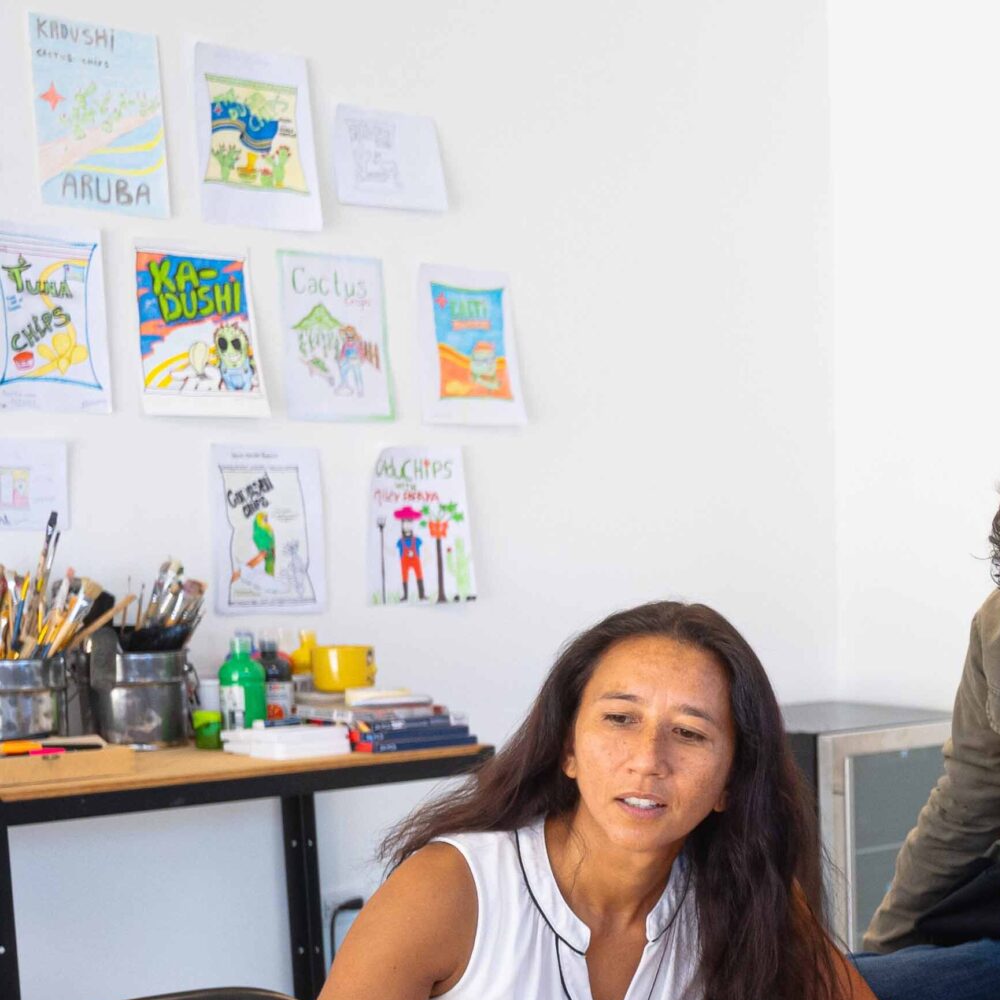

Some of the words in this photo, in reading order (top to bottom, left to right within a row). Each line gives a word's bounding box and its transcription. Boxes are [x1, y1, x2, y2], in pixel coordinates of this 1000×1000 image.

[62, 172, 151, 207] ARUBA
[291, 266, 368, 299] Cactus
[158, 279, 242, 324] DUSHI
